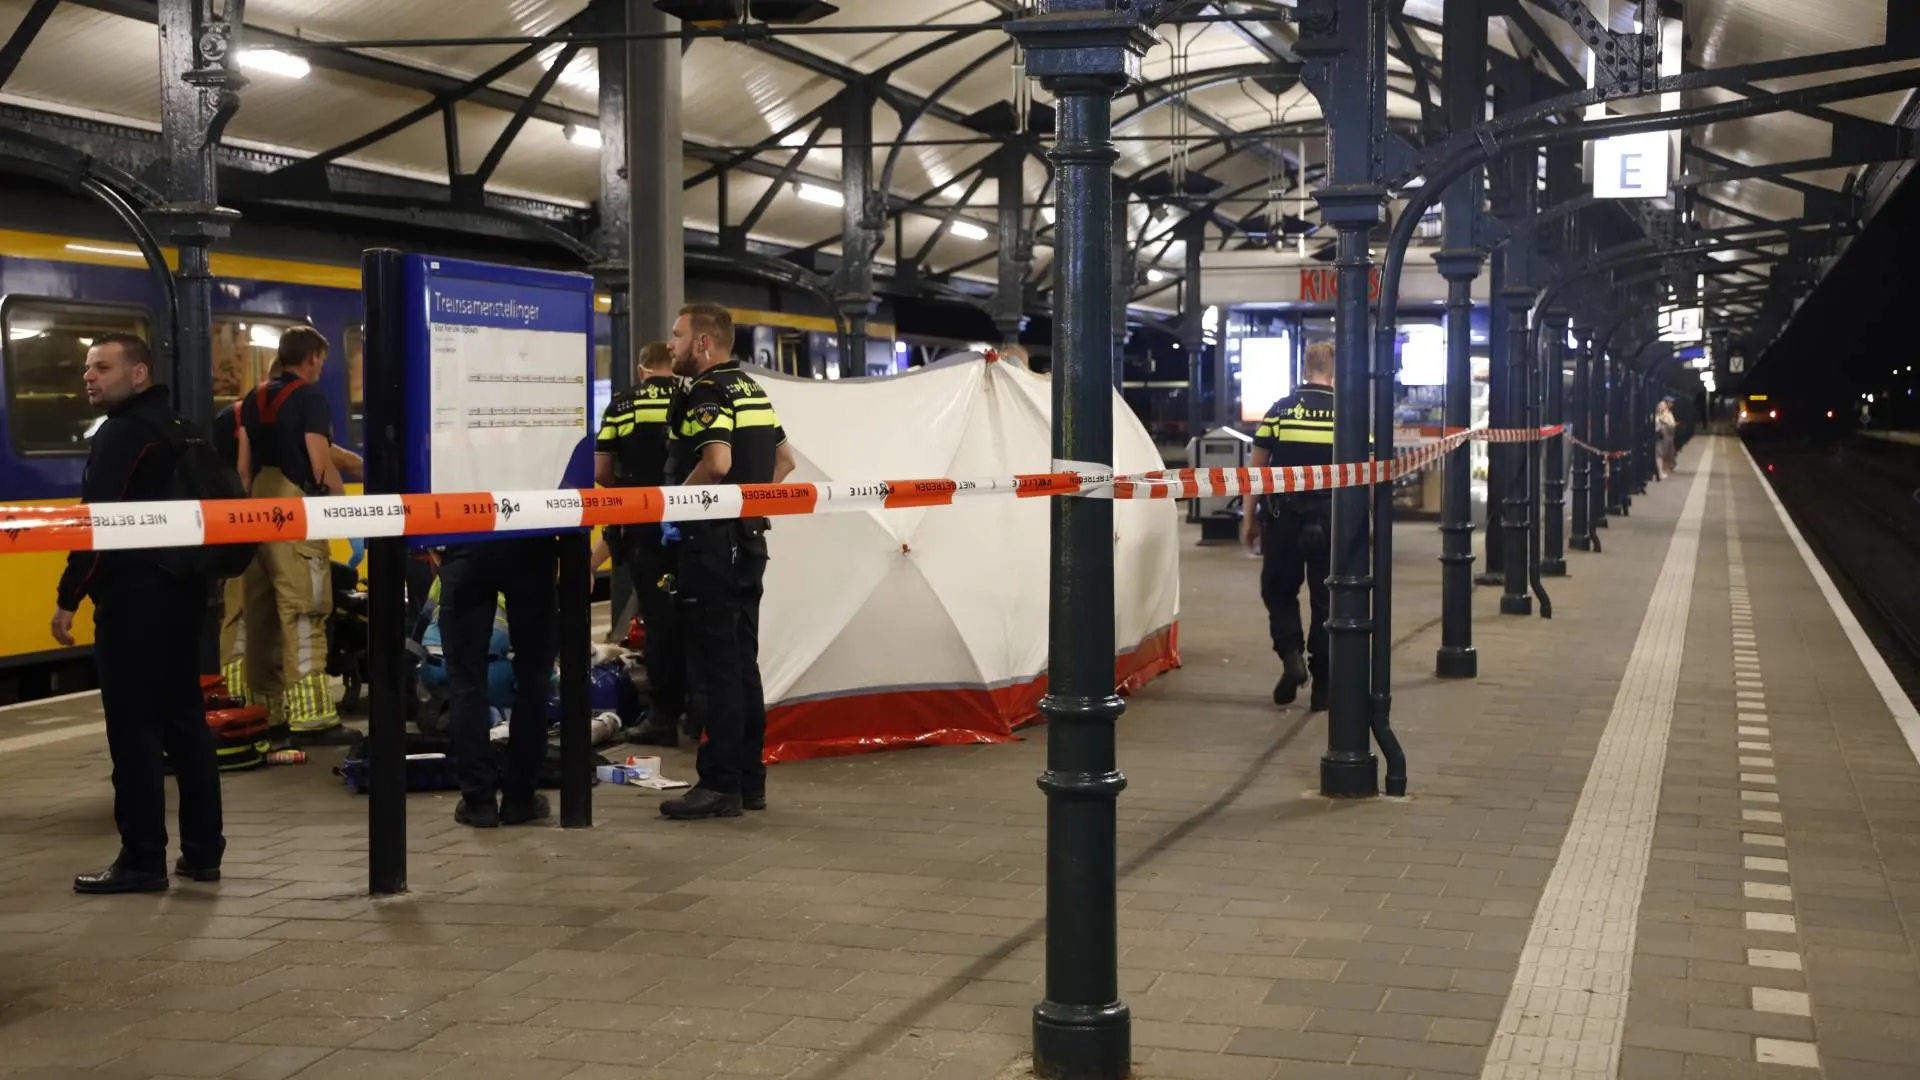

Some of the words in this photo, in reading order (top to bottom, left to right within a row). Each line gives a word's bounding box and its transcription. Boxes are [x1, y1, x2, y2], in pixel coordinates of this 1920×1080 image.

[1620, 153, 1642, 189] E
[1299, 267, 1400, 303] KIS
[850, 483, 895, 500] POLITIE
[915, 480, 957, 492] BETREDEN
[959, 481, 976, 490] NIET
[741, 488, 789, 500] BETREDEN
[790, 488, 810, 498] NIET
[546, 498, 599, 509] BETREDEN
[600, 496, 623, 507] NIET
[669, 491, 719, 509] POLITIE
[323, 506, 385, 518] BETREDEN
[387, 505, 411, 515] NIET
[463, 499, 520, 519] POLITIE
[140, 514, 168, 525] NIET
[228, 508, 295, 529] POLITIE
